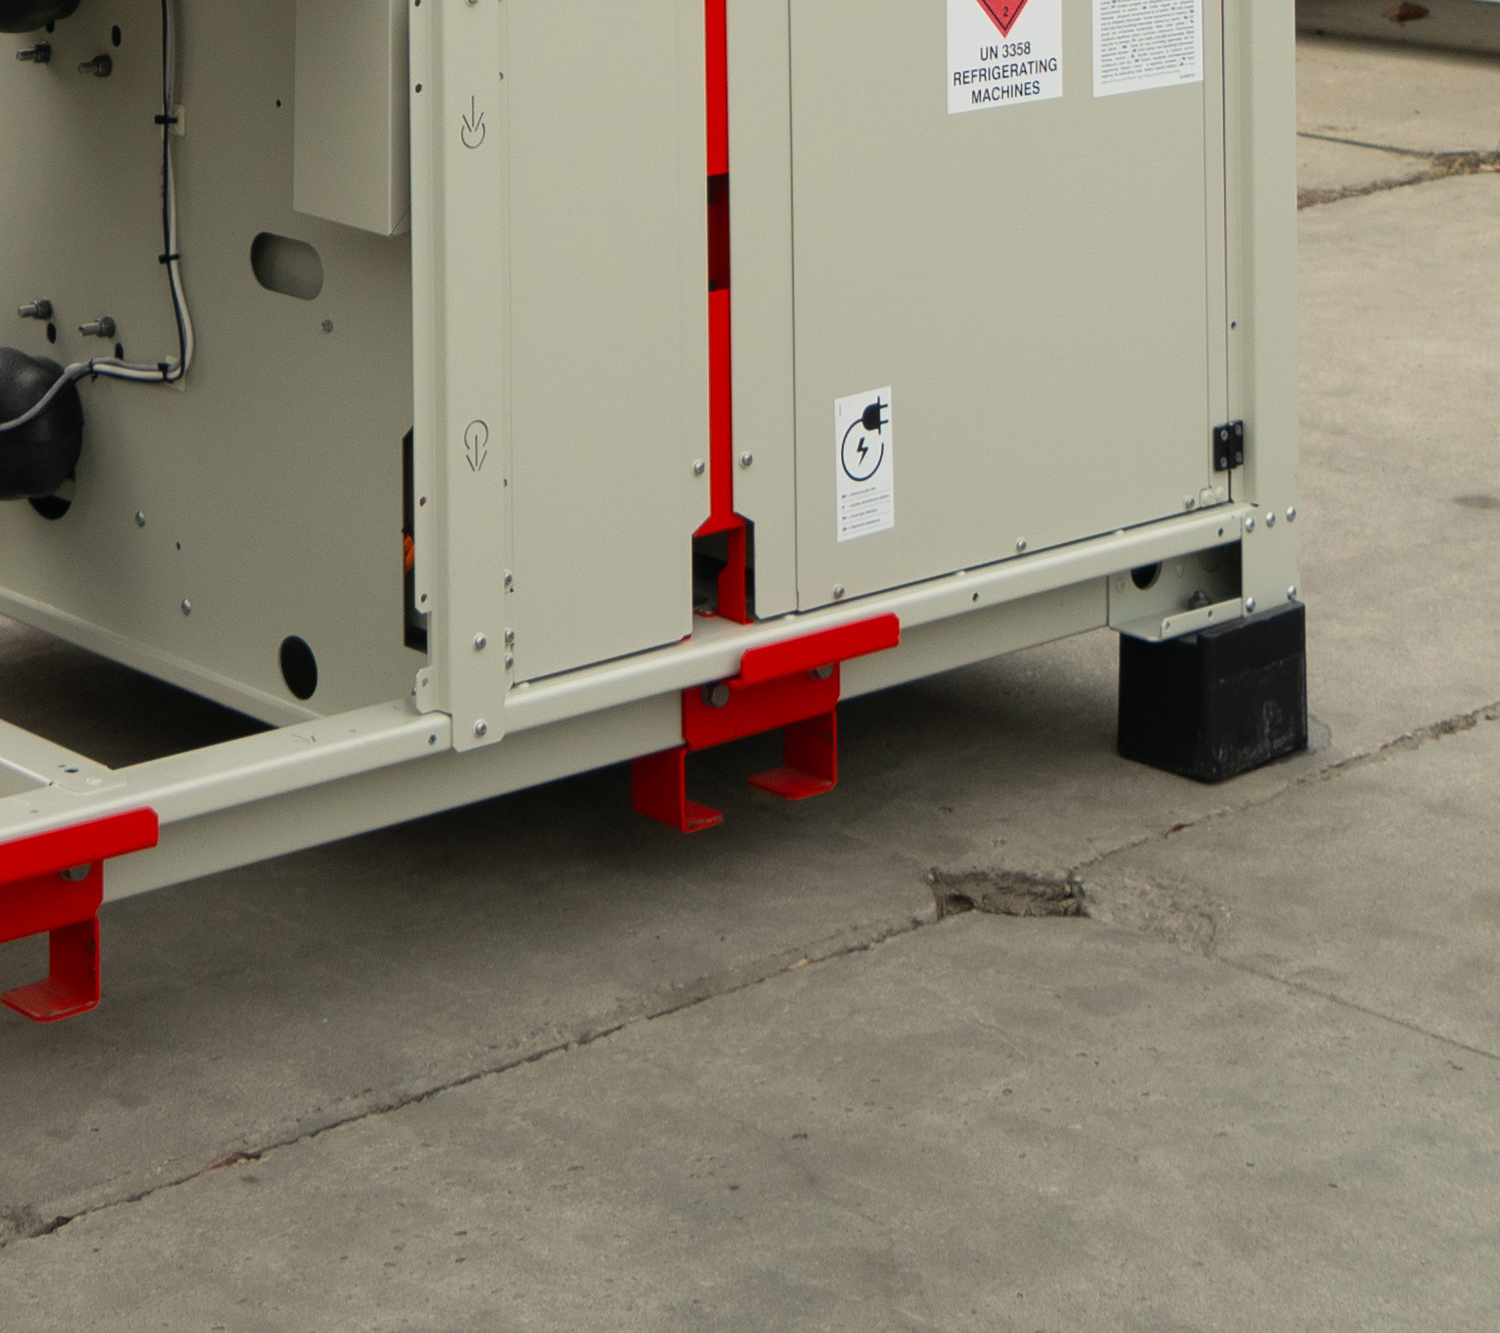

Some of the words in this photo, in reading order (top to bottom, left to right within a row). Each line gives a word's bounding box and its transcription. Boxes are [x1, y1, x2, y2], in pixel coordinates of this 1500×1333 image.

[1002, 6, 1009, 17] 2
[979, 45, 999, 61] UN
[1001, 41, 1031, 59] 3358
[953, 57, 1058, 86] REFRIGERATING
[971, 80, 1041, 104] MACHINES
